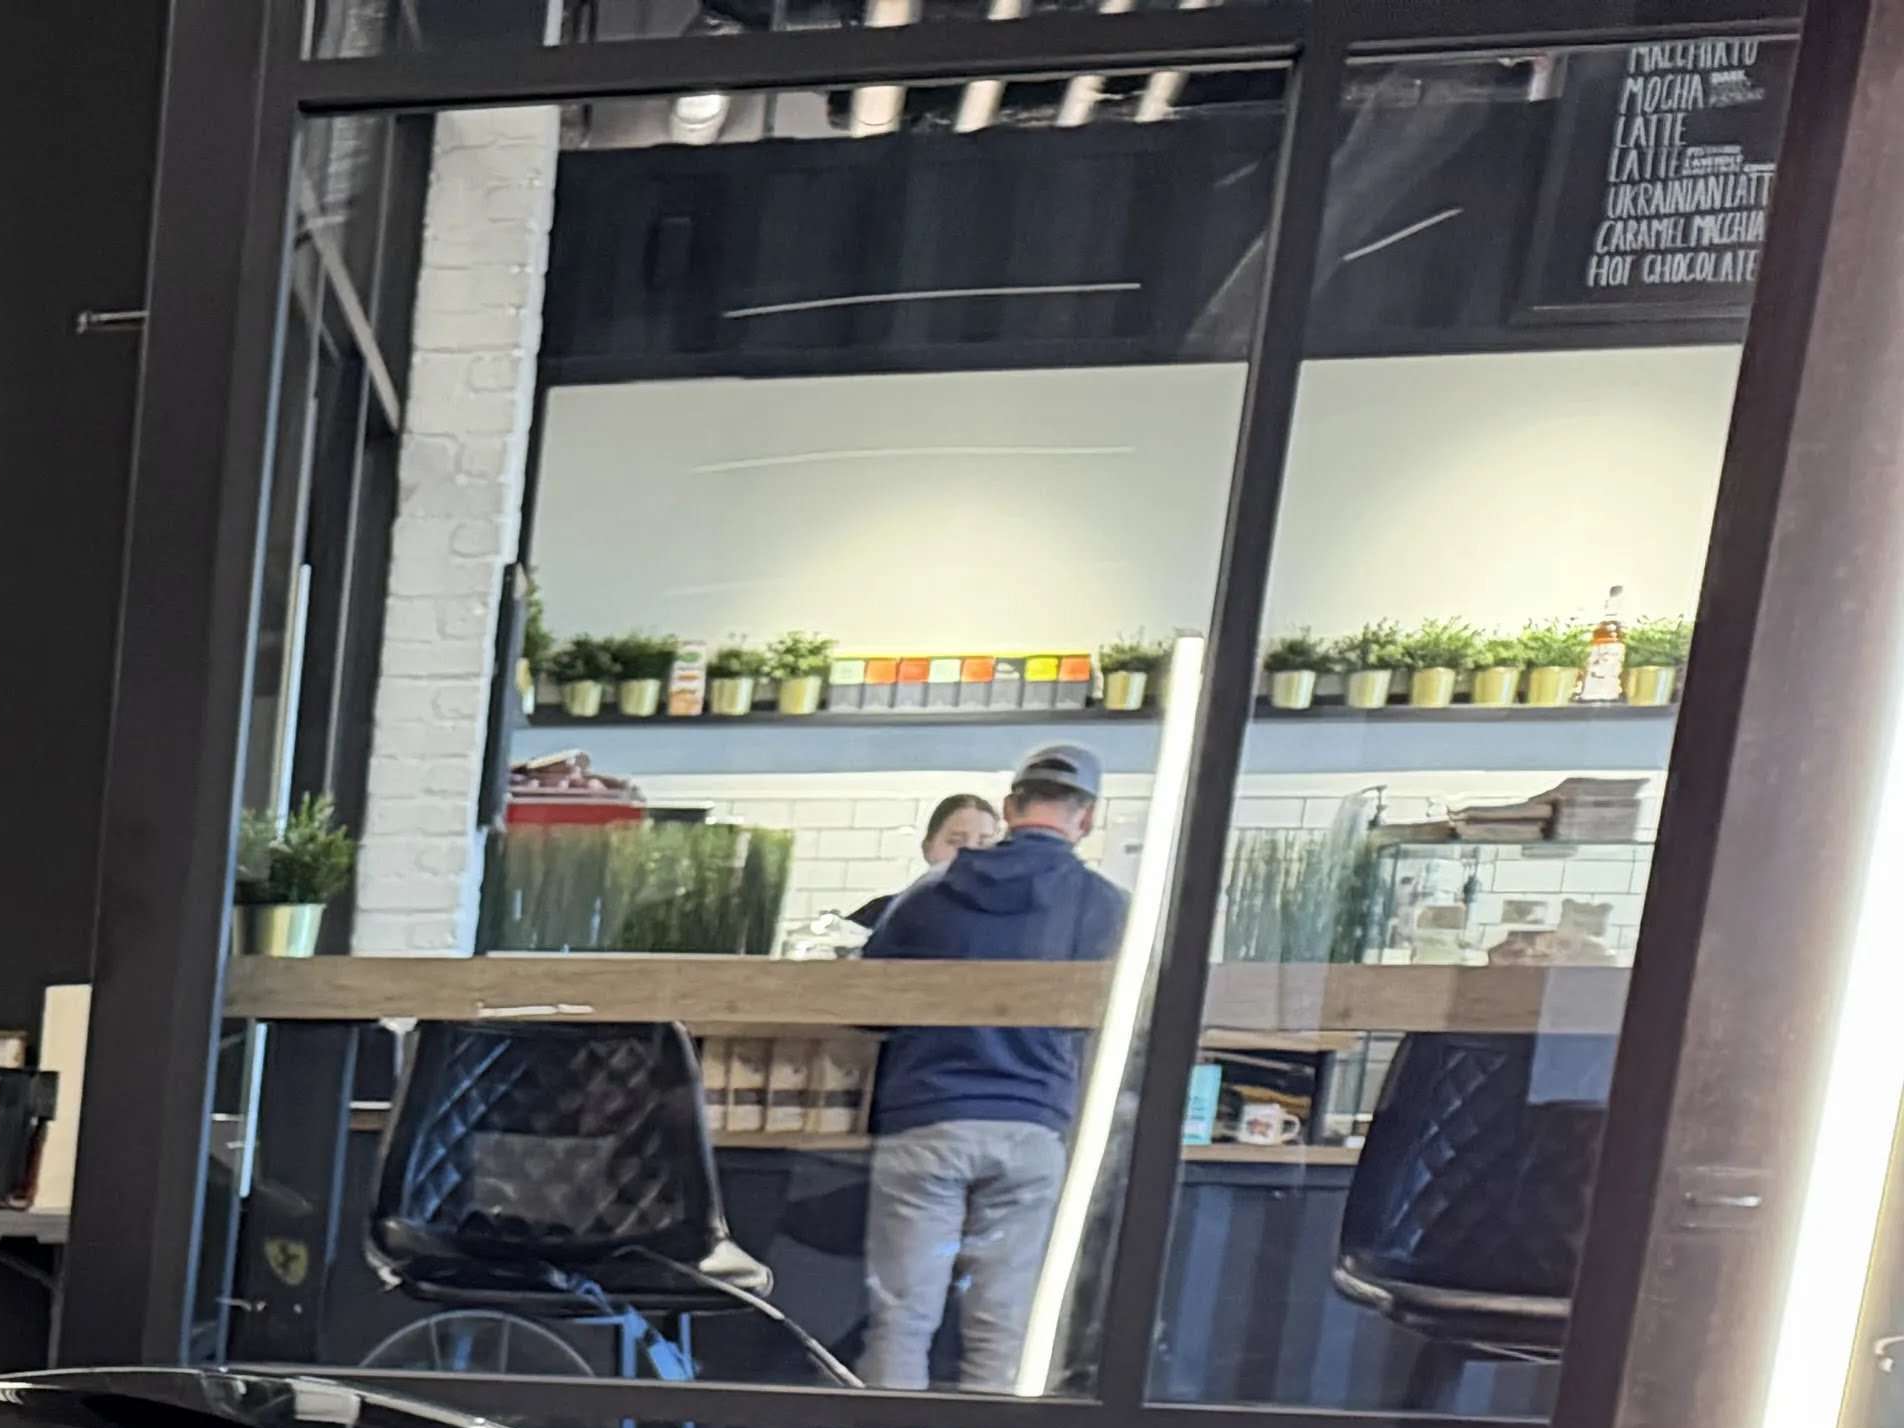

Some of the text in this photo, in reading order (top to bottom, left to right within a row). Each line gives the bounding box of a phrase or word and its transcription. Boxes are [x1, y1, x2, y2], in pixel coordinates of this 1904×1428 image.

[1620, 73, 1704, 114] MOCHA
[1616, 113, 1687, 147] LATTE
[1607, 146, 1681, 182] LATTE
[1607, 171, 1776, 219] UKRAINIAN LATT
[1596, 209, 1767, 254] CARAMEL MACCHIA
[1587, 249, 1760, 287] HOT CHOCOLATE
